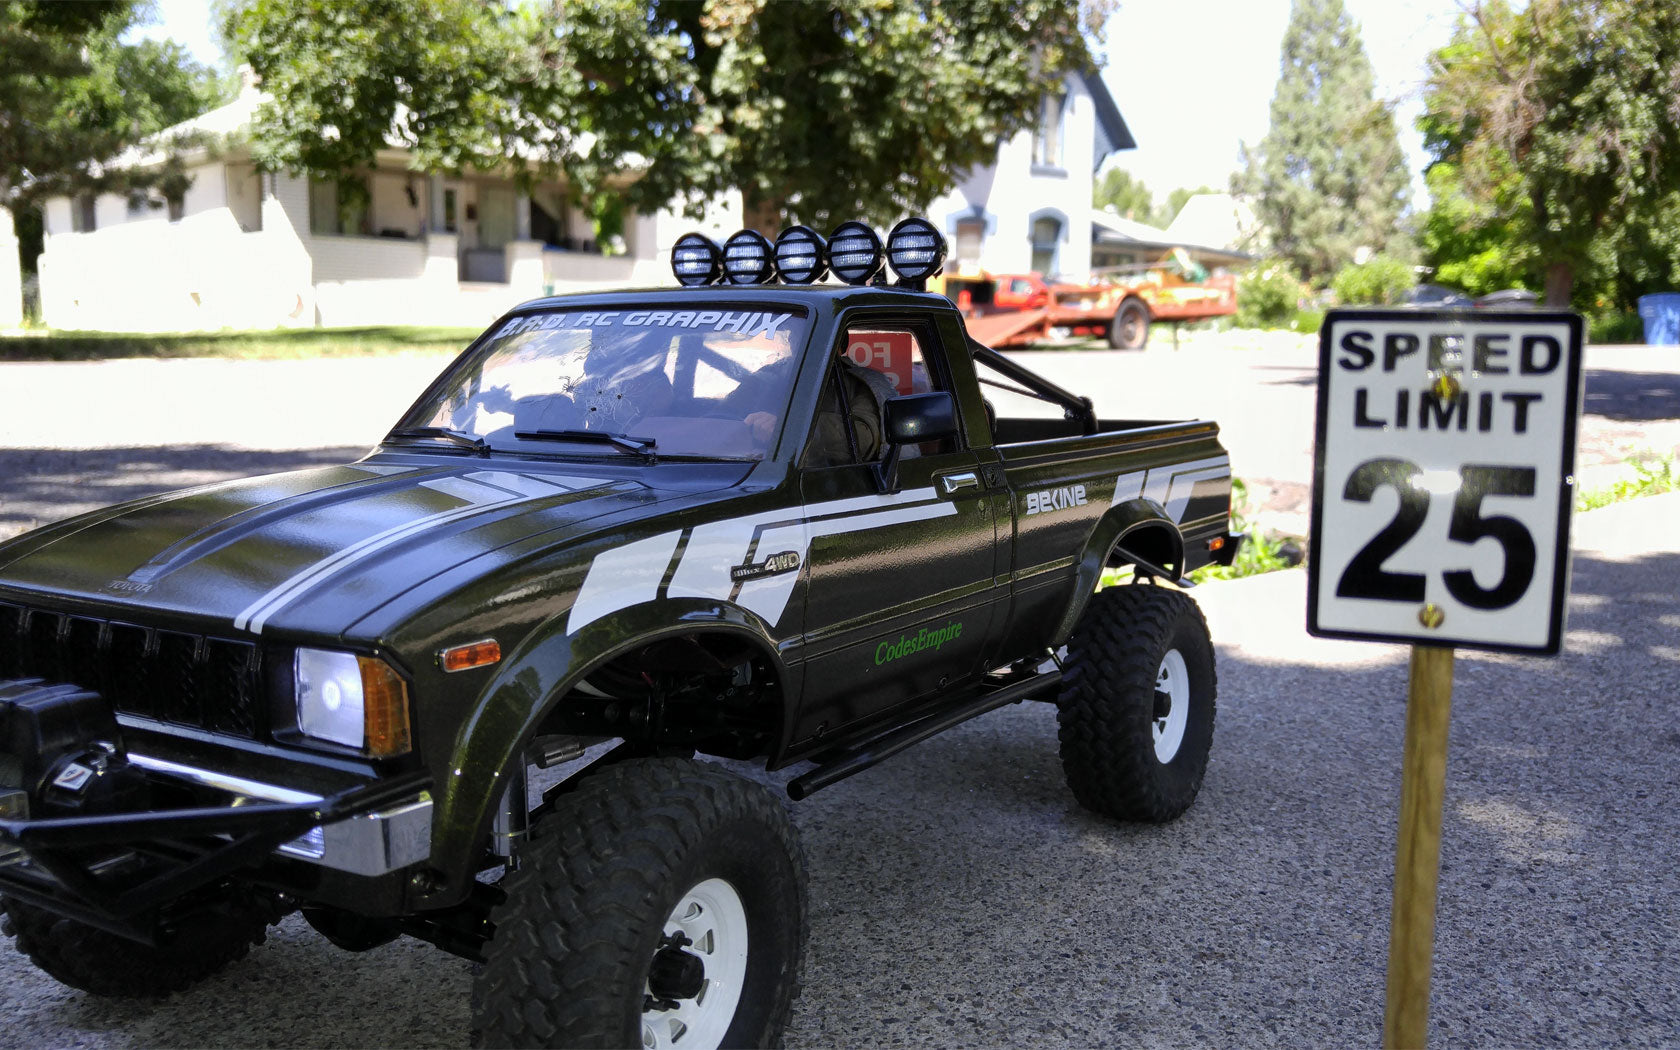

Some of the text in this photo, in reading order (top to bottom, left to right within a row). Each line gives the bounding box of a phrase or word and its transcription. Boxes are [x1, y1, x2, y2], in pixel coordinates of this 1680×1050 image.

[493, 311, 792, 340] B.A.D. RC GRAPHIX
[1338, 331, 1562, 375] SPEED
[1354, 388, 1543, 433] LIMIT
[1335, 457, 1537, 611] 25
[764, 553, 801, 572] 4WD
[875, 621, 963, 665] CodesEmpire
